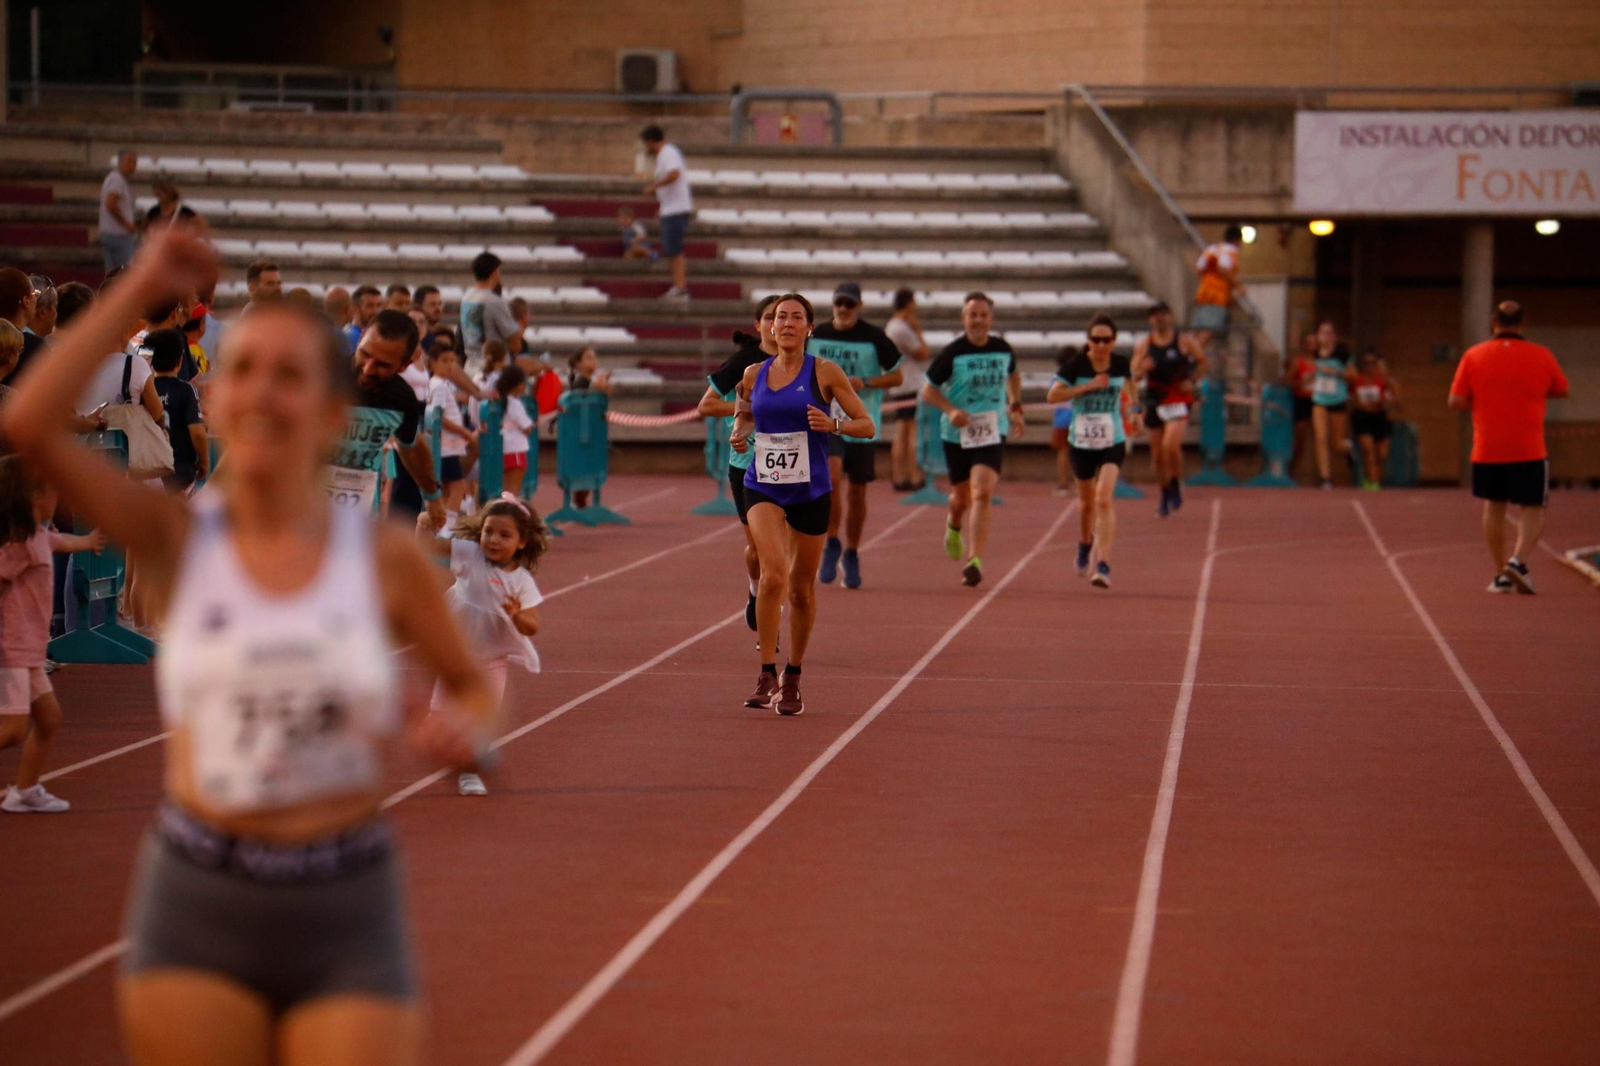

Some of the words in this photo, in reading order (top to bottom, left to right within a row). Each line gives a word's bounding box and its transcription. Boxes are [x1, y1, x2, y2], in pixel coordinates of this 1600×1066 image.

[1340, 120, 1511, 147] INSTALACIÓN
[967, 423, 992, 438] 975
[1084, 426, 1106, 438] 151
[765, 452, 799, 469] 647
